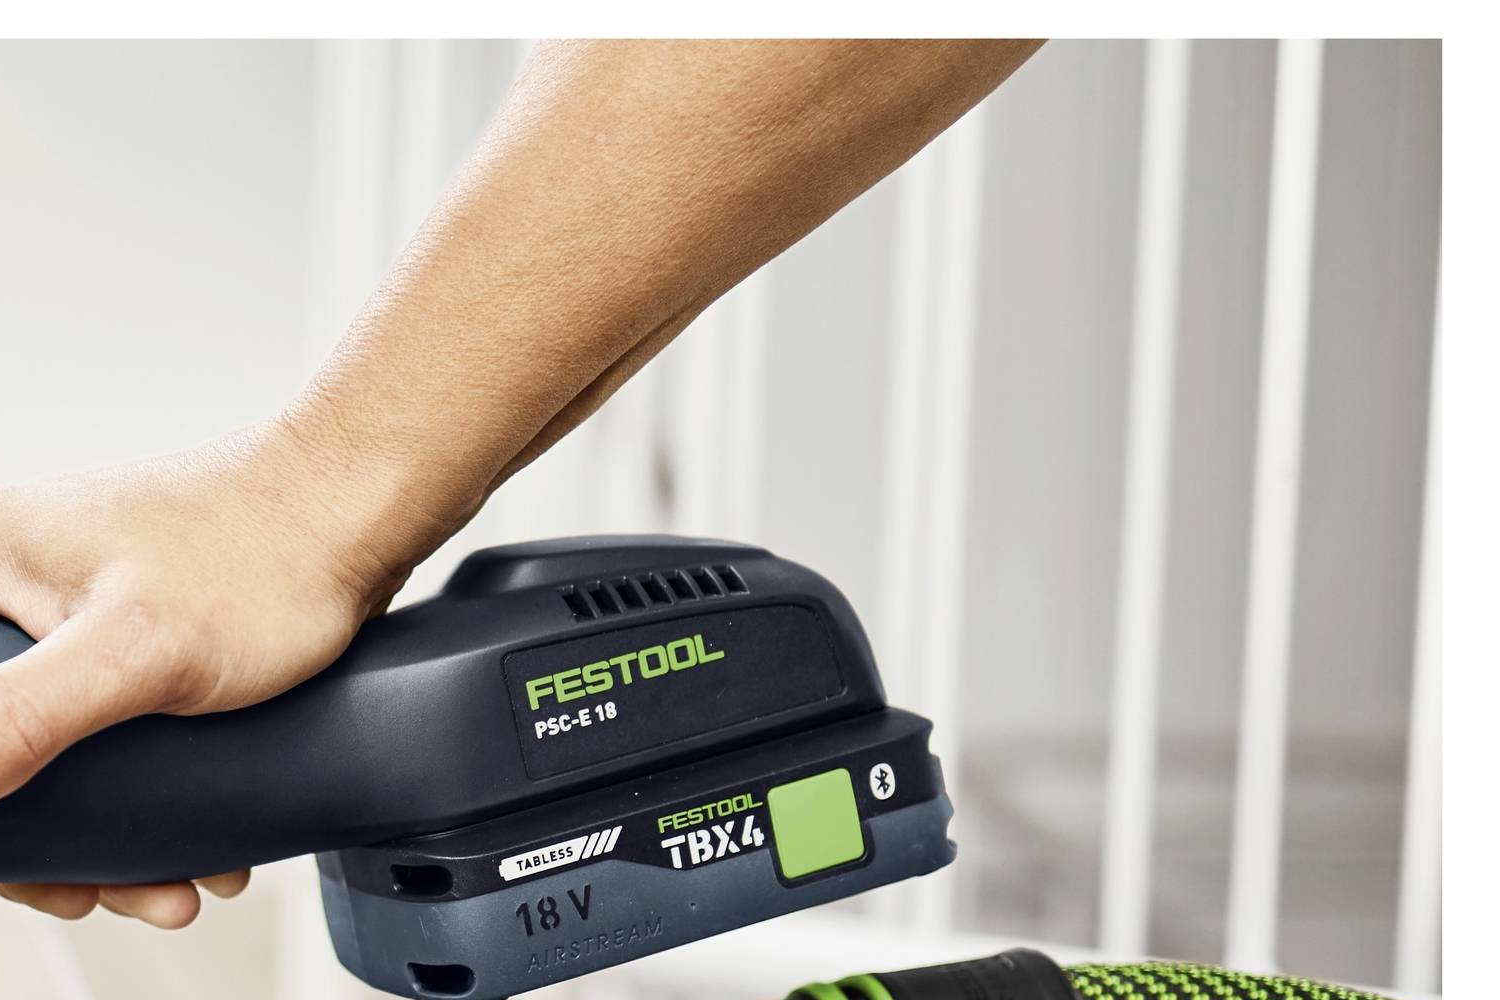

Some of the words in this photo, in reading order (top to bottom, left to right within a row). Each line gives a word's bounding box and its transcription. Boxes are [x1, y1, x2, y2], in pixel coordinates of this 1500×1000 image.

[526, 634, 725, 711] FESTOOL
[534, 708, 593, 740] PSC-E
[594, 701, 618, 722] 18
[657, 793, 763, 834] FESTOOL
[516, 846, 574, 872] TABLESS
[661, 815, 765, 869] TBX4
[515, 896, 561, 937] 18
[566, 883, 591, 921] V
[526, 915, 665, 975] AIRSTREAM
